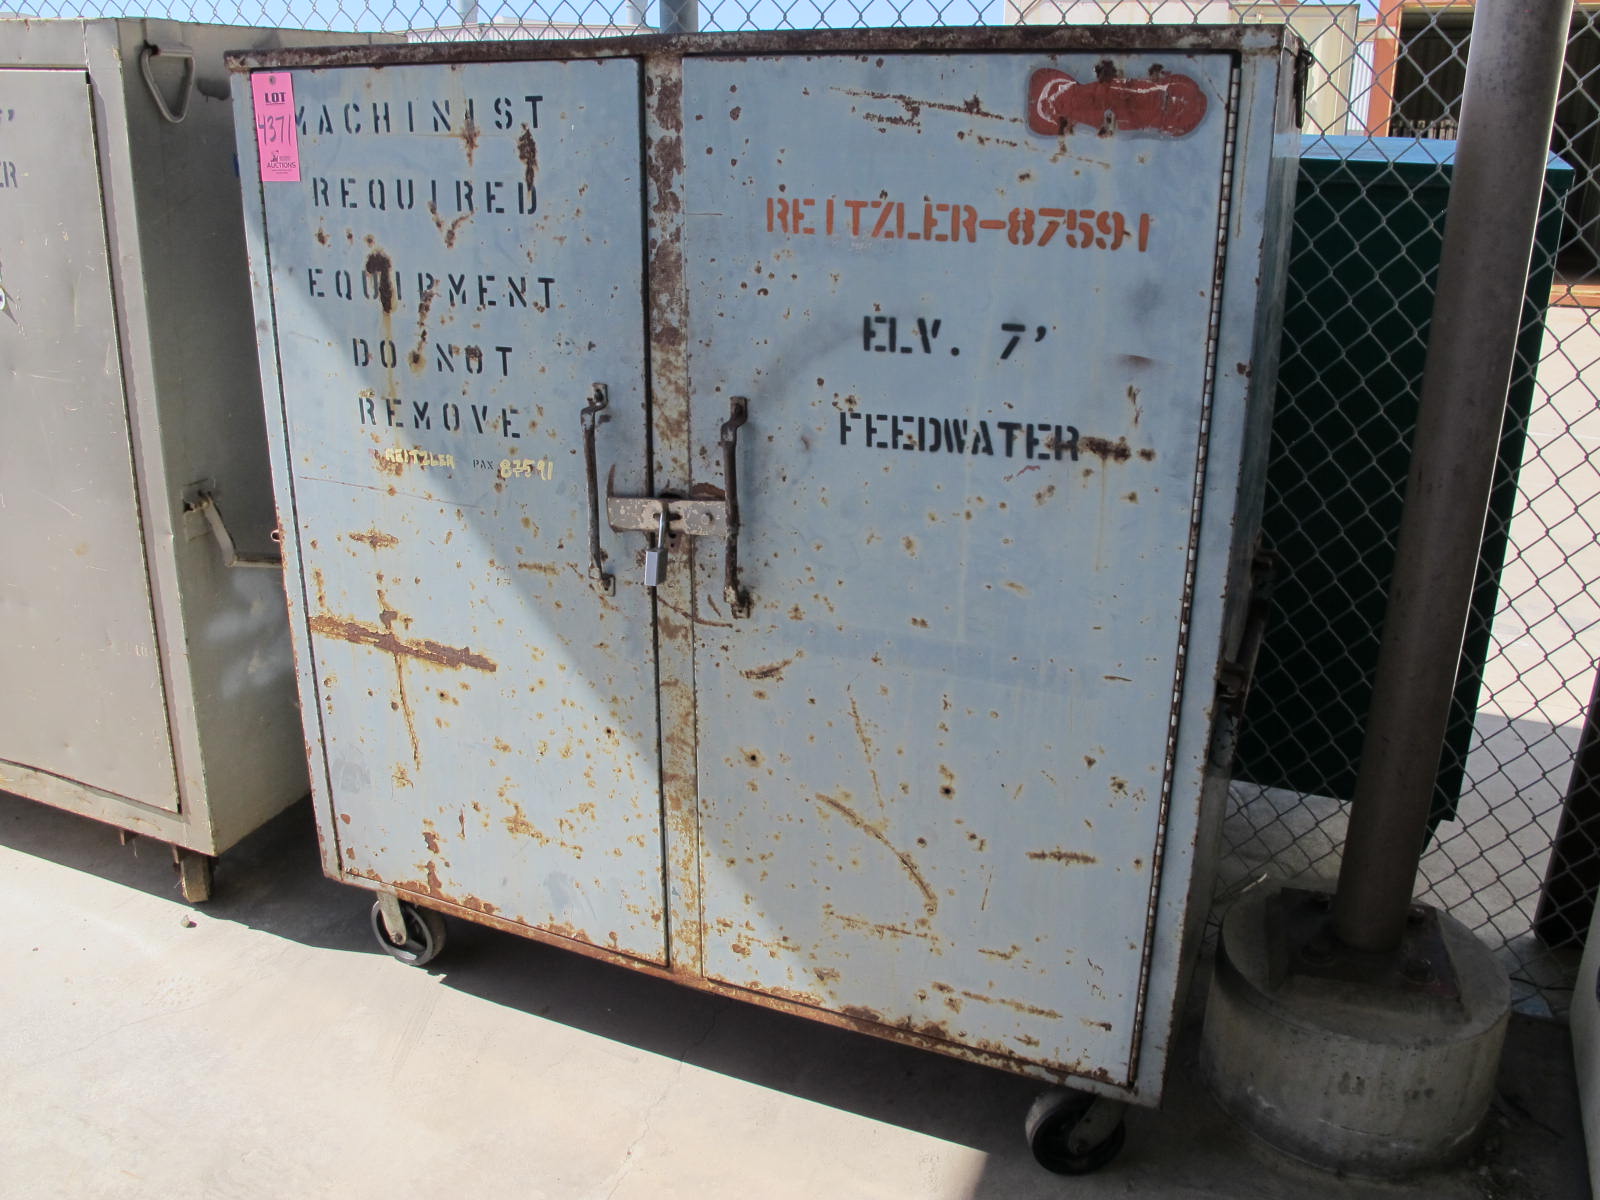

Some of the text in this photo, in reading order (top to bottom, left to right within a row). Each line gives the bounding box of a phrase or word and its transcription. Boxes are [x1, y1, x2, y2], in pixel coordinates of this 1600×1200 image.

[264, 92, 286, 103] LOT
[257, 113, 292, 146] 4371
[312, 177, 538, 215] REQUIRED
[766, 197, 1150, 253] REITZLER-87591
[308, 268, 556, 309] EQUIPMENT
[863, 315, 960, 357] ELV.
[352, 338, 513, 377] DO NOT
[358, 397, 521, 439] REMOVE
[840, 412, 1080, 462] FEEDWATER
[500, 458, 554, 481] 87591
